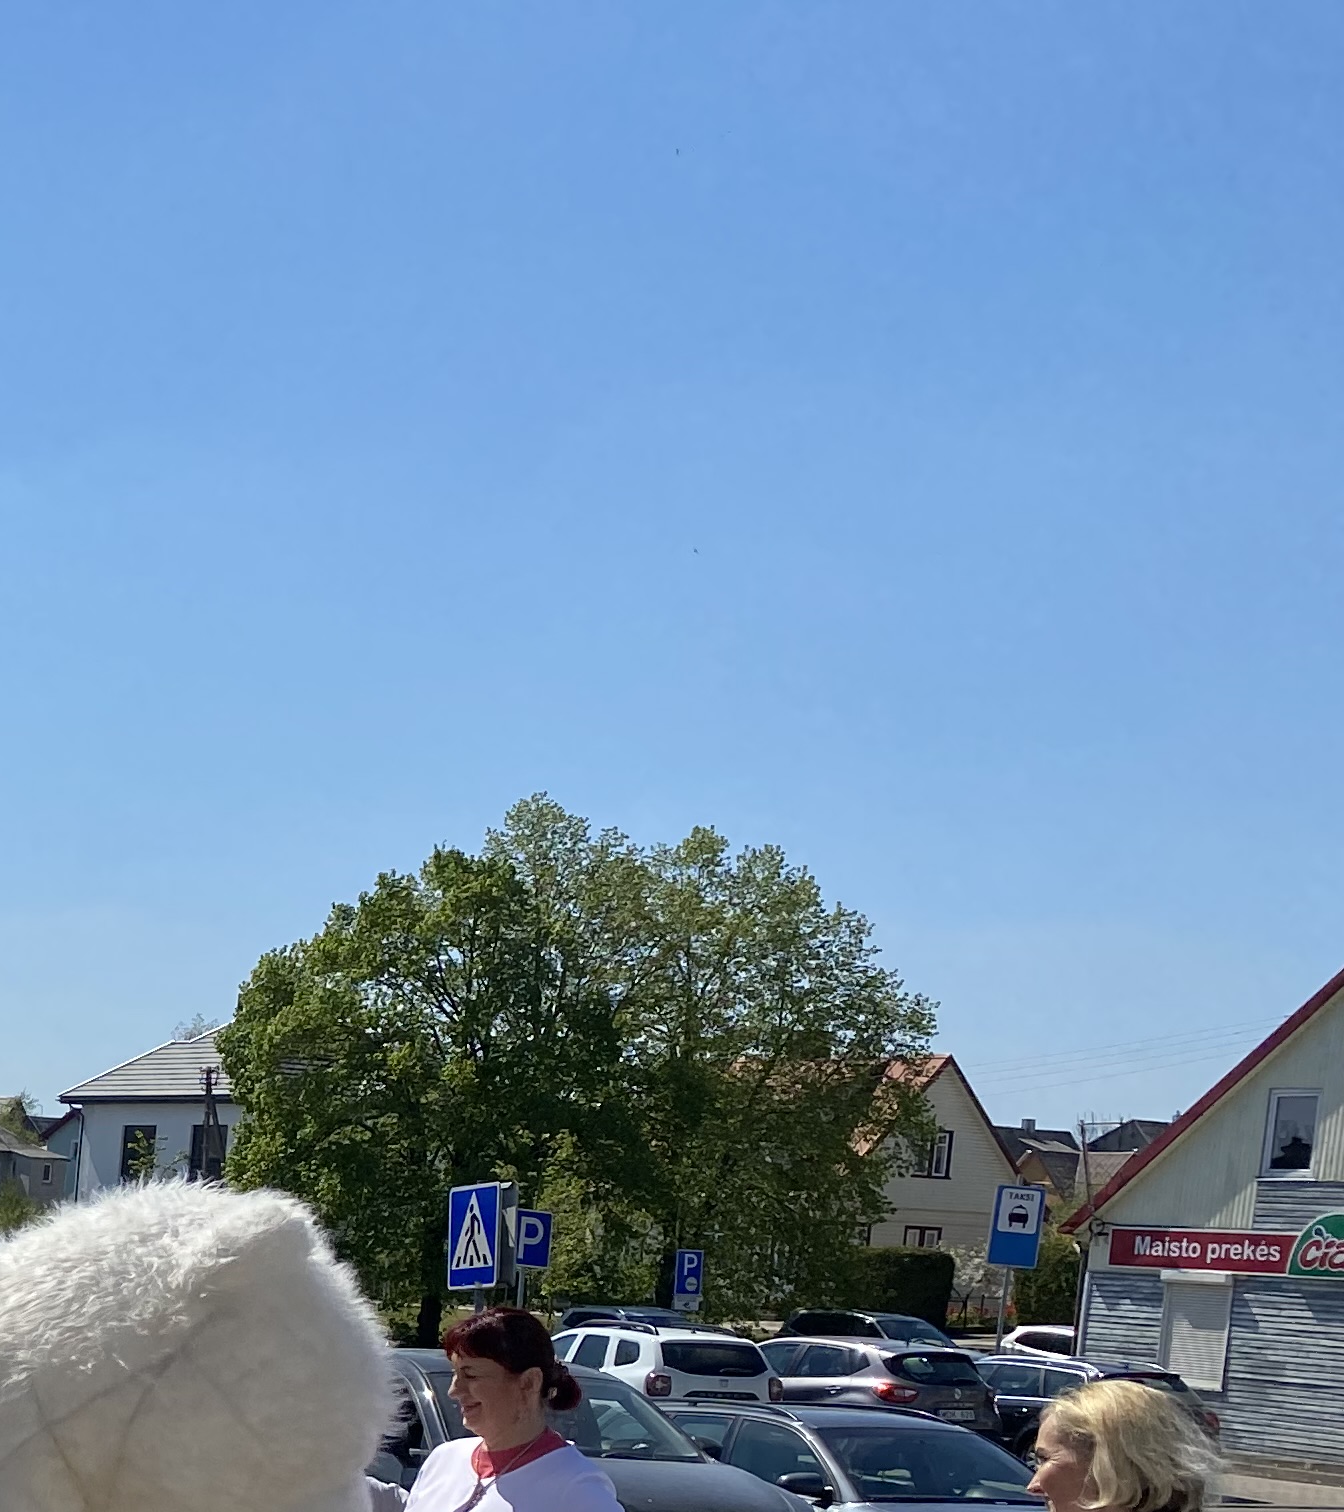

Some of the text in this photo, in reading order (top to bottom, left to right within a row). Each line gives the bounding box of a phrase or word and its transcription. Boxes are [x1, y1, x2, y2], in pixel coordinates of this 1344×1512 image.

[516, 1216, 544, 1260] P
[1134, 1235, 1281, 1264] Maisto prekės
[683, 1253, 698, 1276] P
